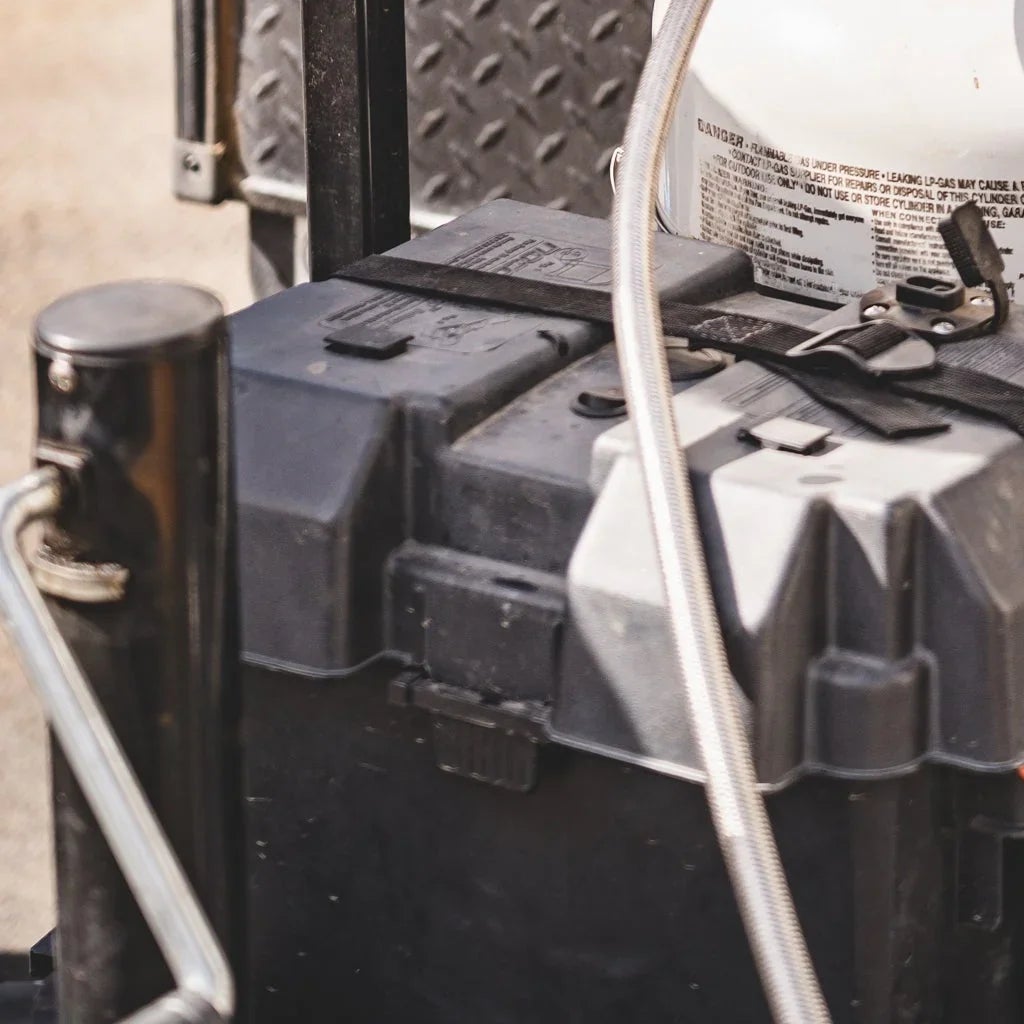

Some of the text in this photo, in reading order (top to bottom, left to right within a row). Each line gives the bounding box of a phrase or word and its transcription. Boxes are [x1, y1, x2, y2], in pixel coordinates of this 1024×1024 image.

[697, 118, 744, 148] DANGER
[811, 158, 837, 172] UNDER
[840, 164, 880, 180] PRESSURE
[887, 172, 922, 186] LEAKING
[924, 176, 957, 189] LP-GAS
[957, 179, 976, 190] MAY
[978, 180, 1009, 191] CAUSE
[1012, 181, 1020, 191] A
[731, 149, 762, 168] CONTACT
[828, 174, 844, 187] FOR
[845, 177, 878, 193] REPAIRS
[879, 183, 891, 194] OR
[893, 185, 935, 200] DISPOSAL
[937, 190, 948, 201] OF
[949, 191, 969, 202] THIS
[972, 192, 1017, 205] CYLINDER
[804, 183, 816, 195] DO
[817, 186, 833, 197] NOT
[834, 190, 849, 202] USE
[852, 193, 862, 203] OR
[864, 194, 890, 207] STORE
[892, 198, 934, 214] CYLINDER
[936, 204, 945, 214] IN
[871, 209, 896, 220] WHEN
